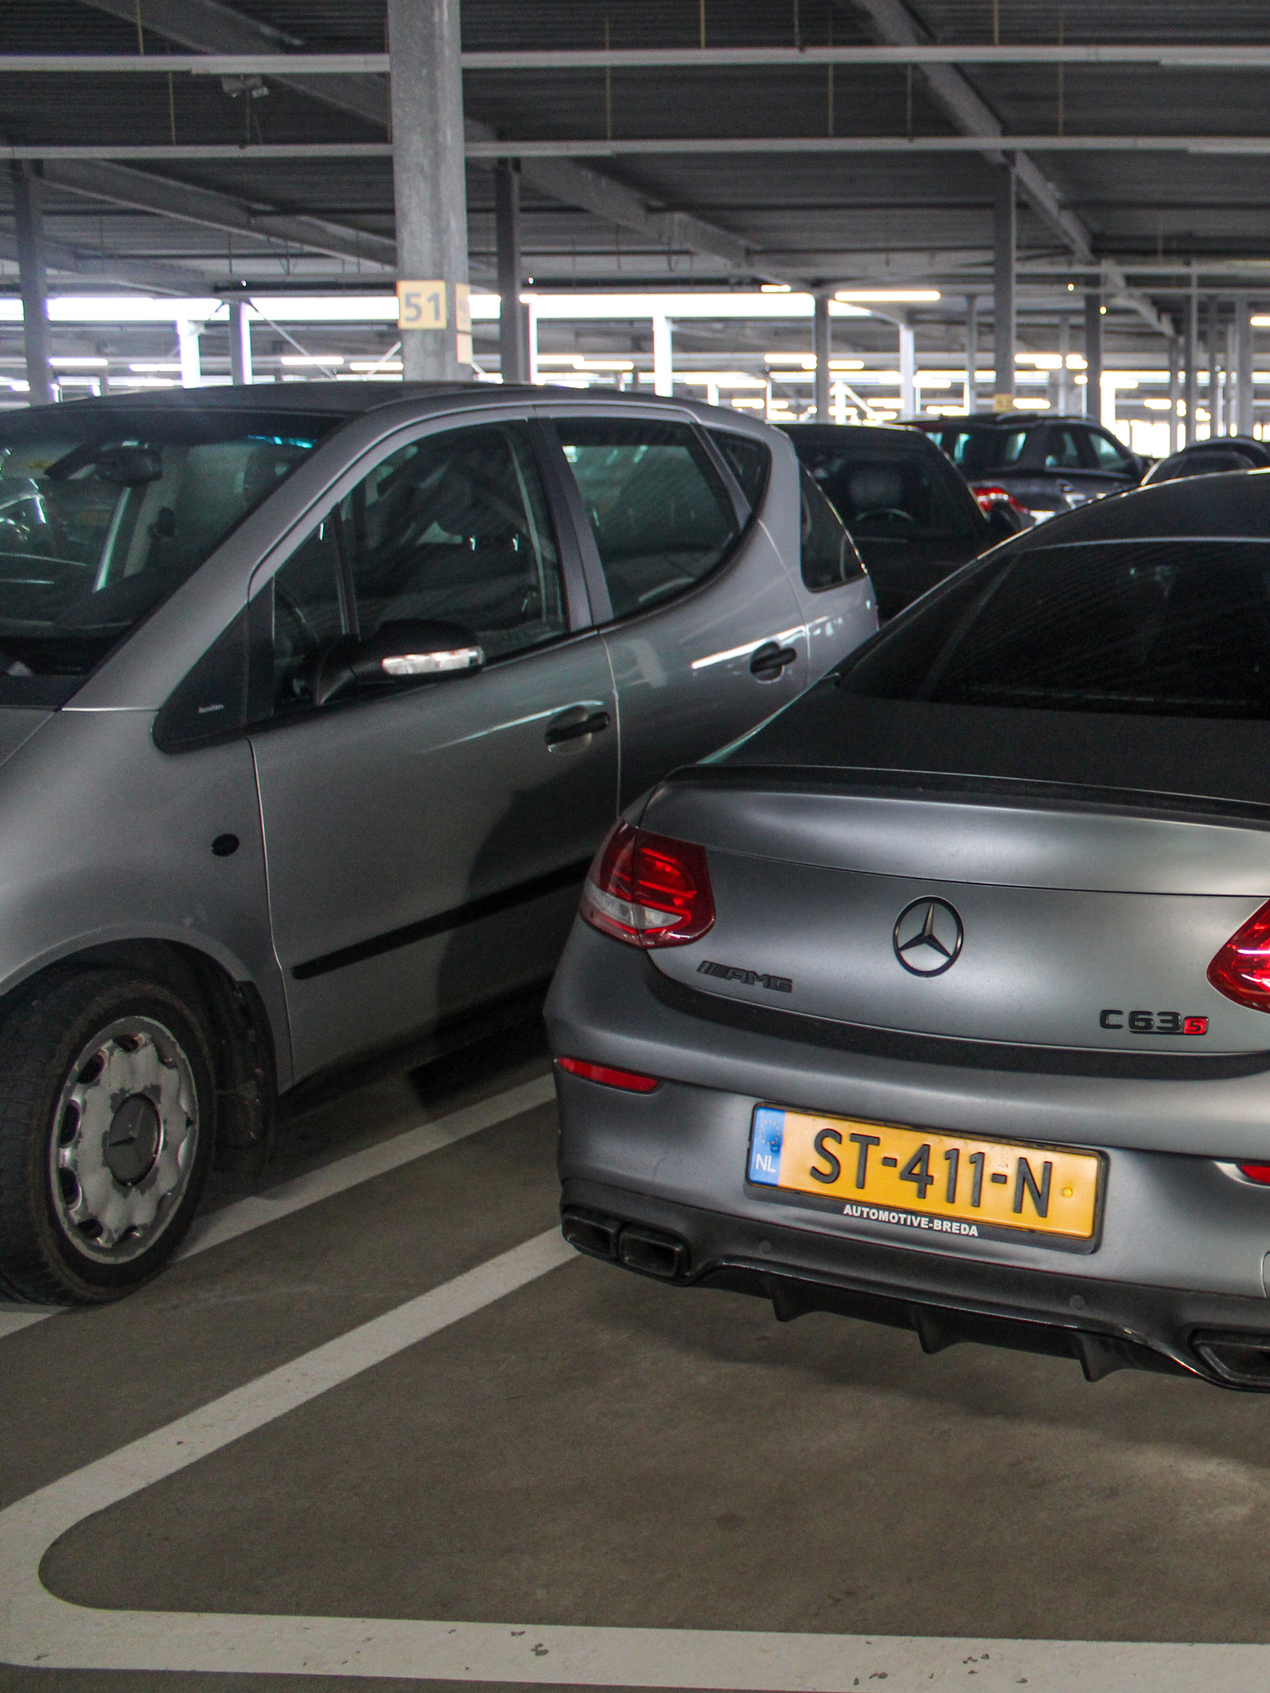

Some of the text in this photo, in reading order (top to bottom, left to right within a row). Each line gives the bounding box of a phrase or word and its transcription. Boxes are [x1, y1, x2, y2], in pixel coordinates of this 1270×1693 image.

[404, 292, 441, 322] 51
[754, 1153, 777, 1174] NL
[809, 1127, 1053, 1218] ST-411-N
[842, 1204, 979, 1238] AUTOMOTIVE-BREDA
